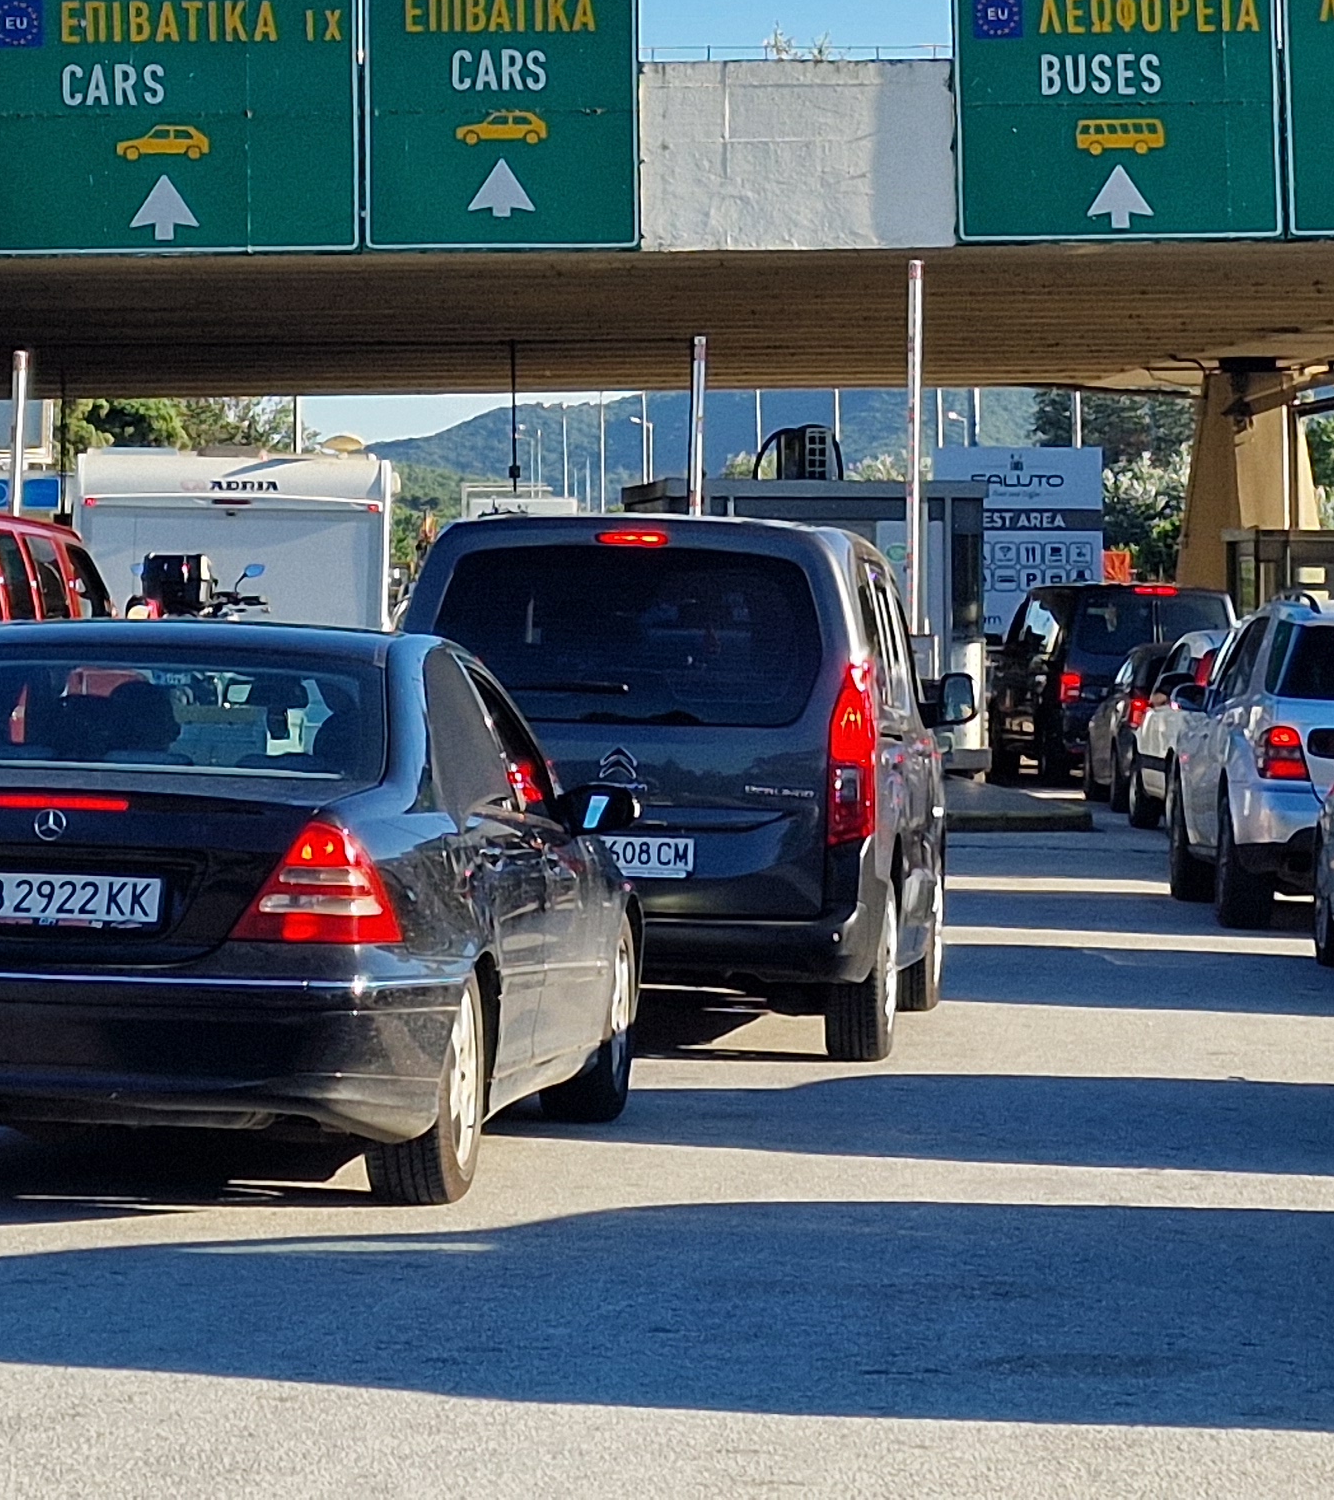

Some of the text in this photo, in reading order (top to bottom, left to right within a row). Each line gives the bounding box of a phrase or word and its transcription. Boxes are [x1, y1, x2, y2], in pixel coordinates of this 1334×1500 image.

[5, 16, 28, 30] EU
[60, 0, 278, 45] ΕΠΙΒΑΤΙΚΑ
[987, 7, 1009, 21] EU
[450, 49, 547, 92] CARS
[1040, 53, 1163, 97] BUSES
[61, 63, 166, 107] CARS
[210, 480, 279, 492] ADRIA
[982, 511, 1066, 528] EST AREA
[1026, 572, 1037, 588] P
[605, 840, 690, 867] 608 CM
[13, 879, 100, 916] 2922
[105, 881, 152, 918] KK
